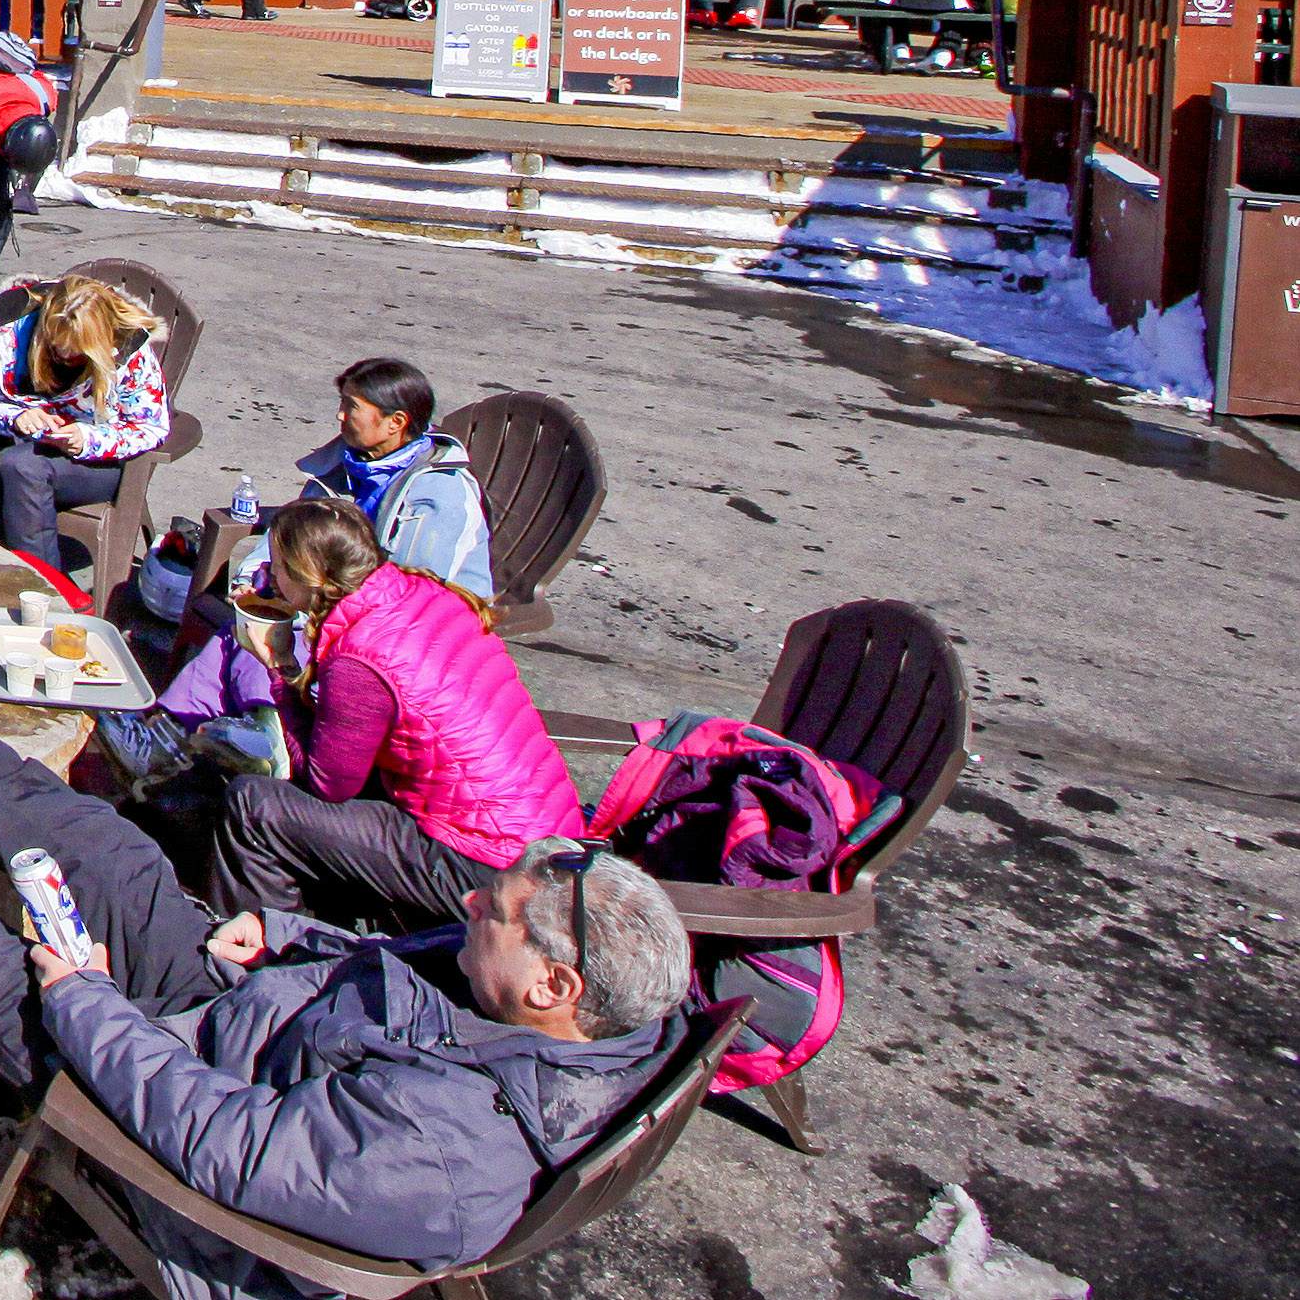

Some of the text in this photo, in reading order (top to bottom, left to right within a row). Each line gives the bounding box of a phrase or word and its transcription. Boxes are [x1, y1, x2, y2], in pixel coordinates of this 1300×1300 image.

[454, 3, 534, 13] BOTTLED WATER
[567, 6, 679, 20] or snowboards
[485, 14, 501, 22] OR
[465, 24, 520, 34] GATORADE
[573, 26, 671, 41] on deck or in
[477, 37, 505, 46] AFTER
[478, 56, 503, 64] DAILY
[580, 46, 661, 65] the Lodge.
